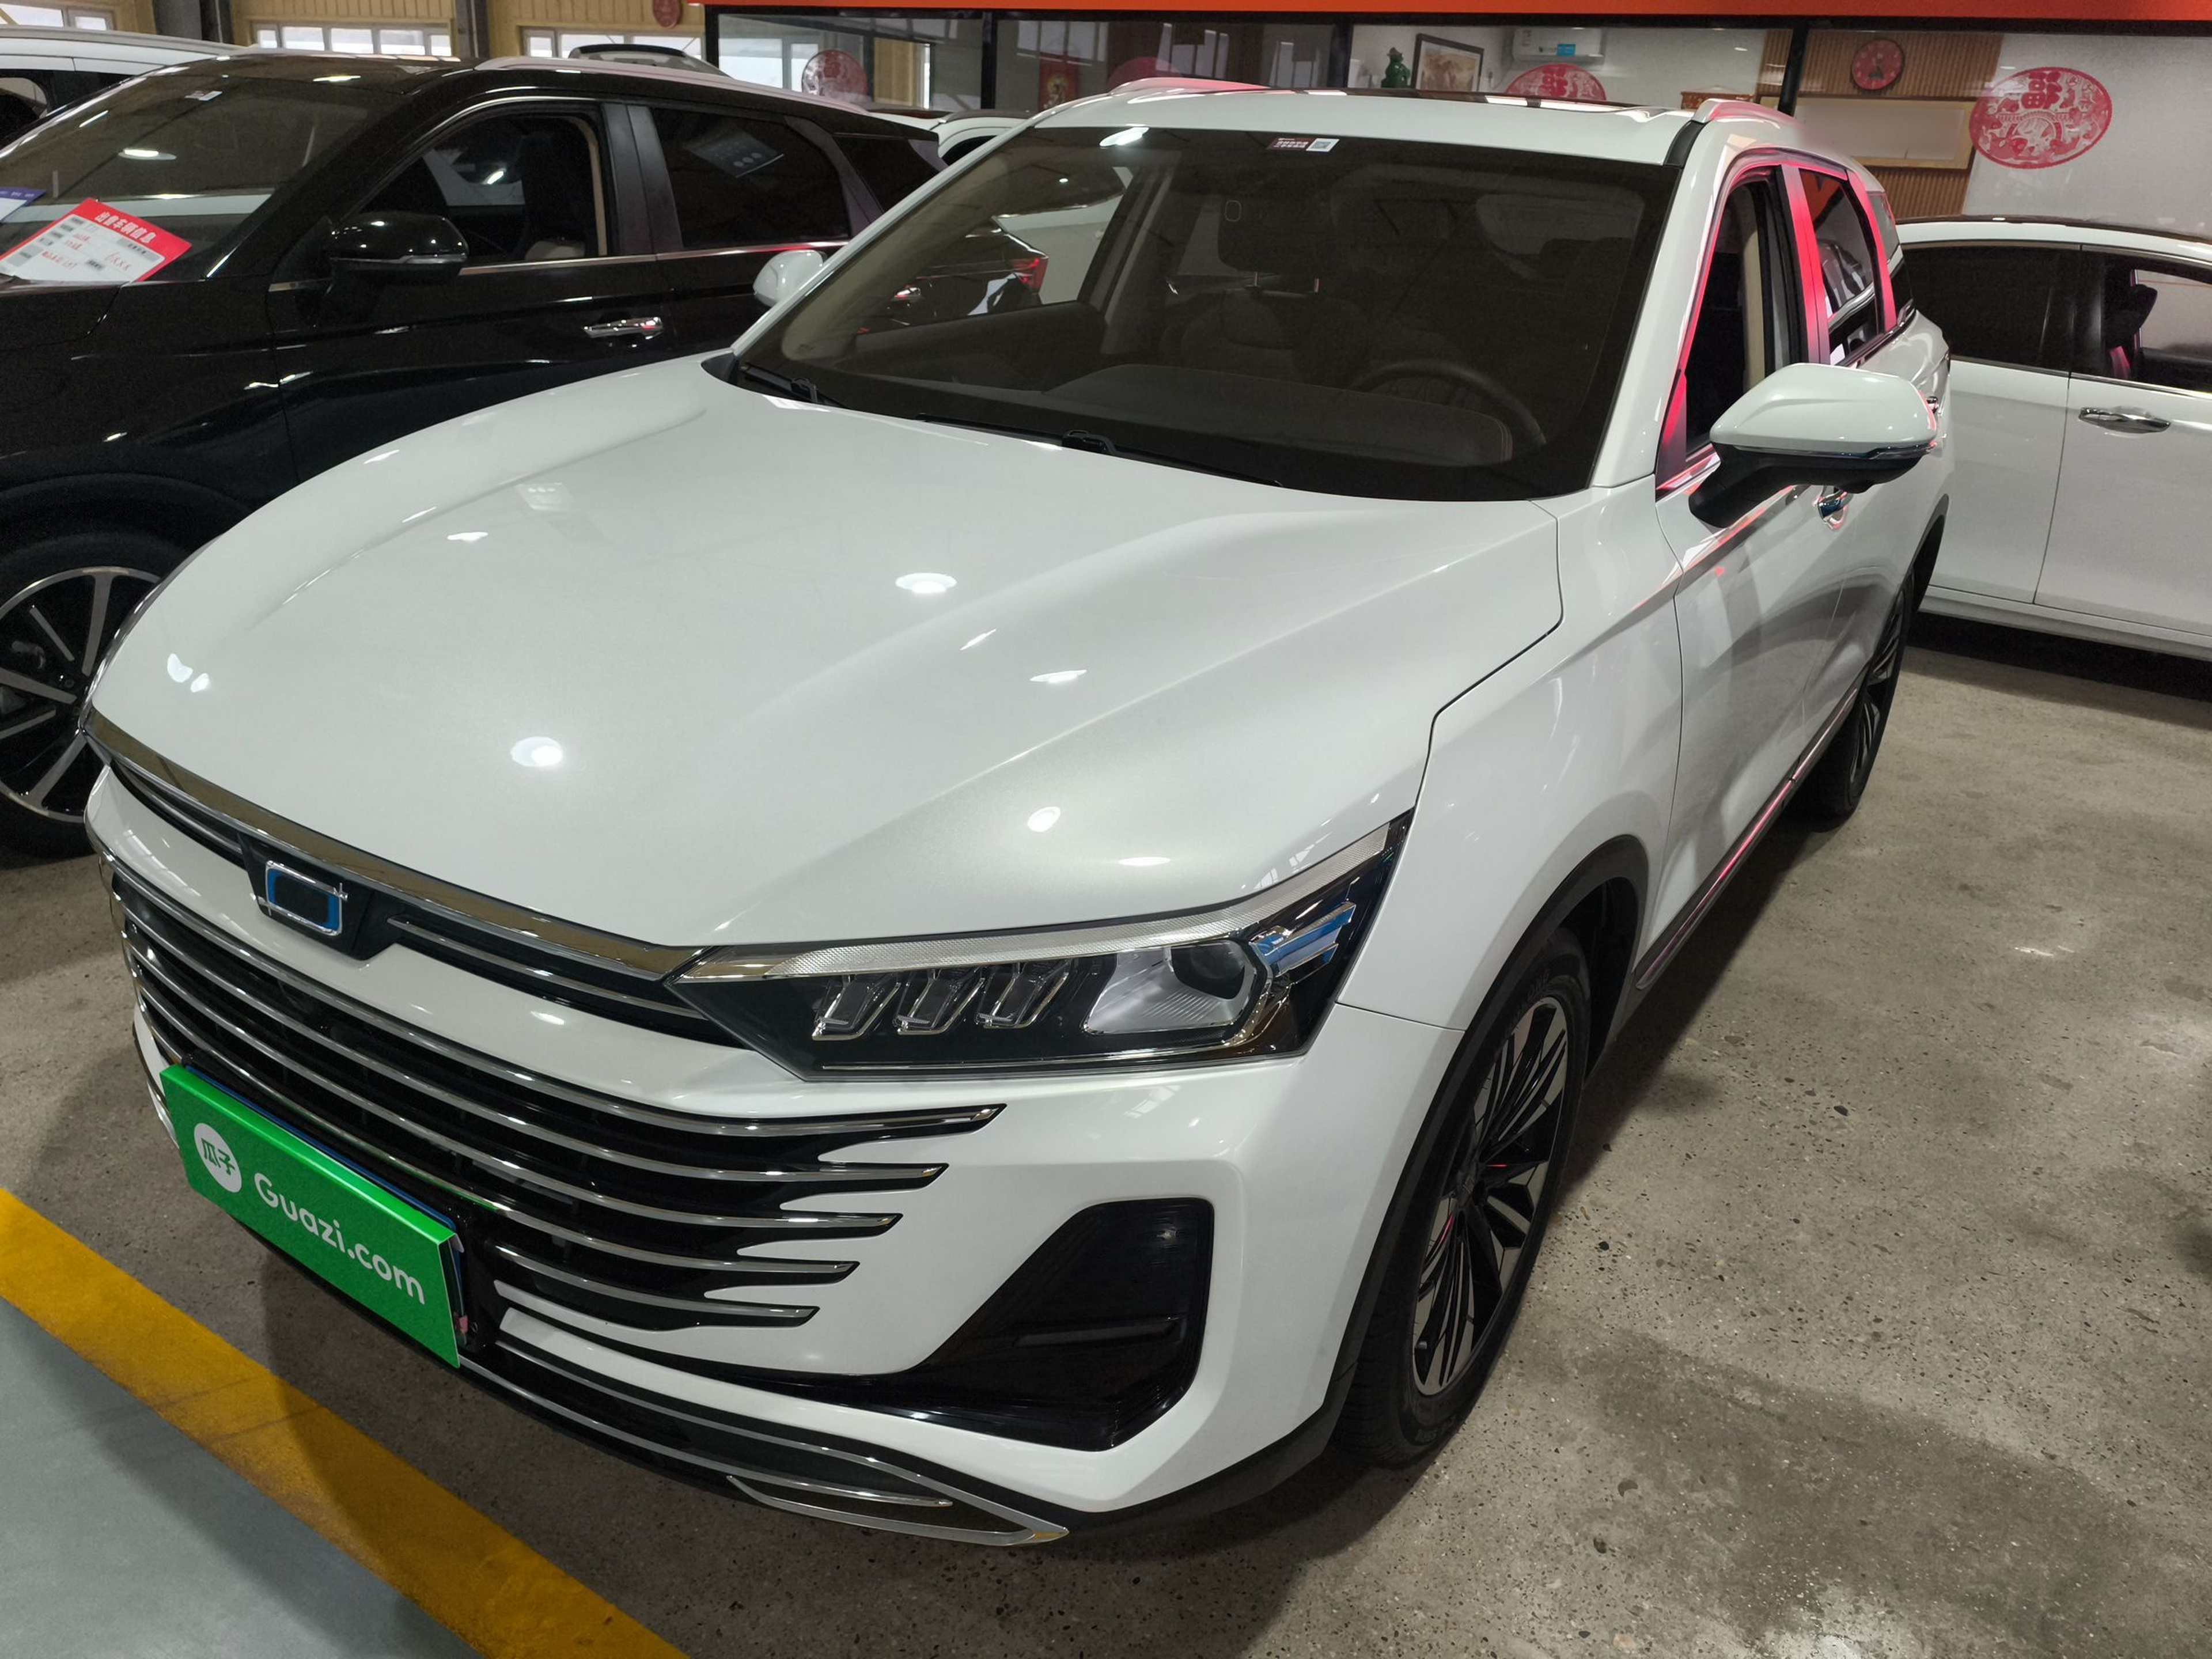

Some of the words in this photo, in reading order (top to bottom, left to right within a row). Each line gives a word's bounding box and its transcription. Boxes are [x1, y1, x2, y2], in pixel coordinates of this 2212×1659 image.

[94, 211, 157, 244] 出售车辆信息
[201, 1137, 235, 1175] 瓜子
[254, 1172, 425, 1305] Guazi.com
